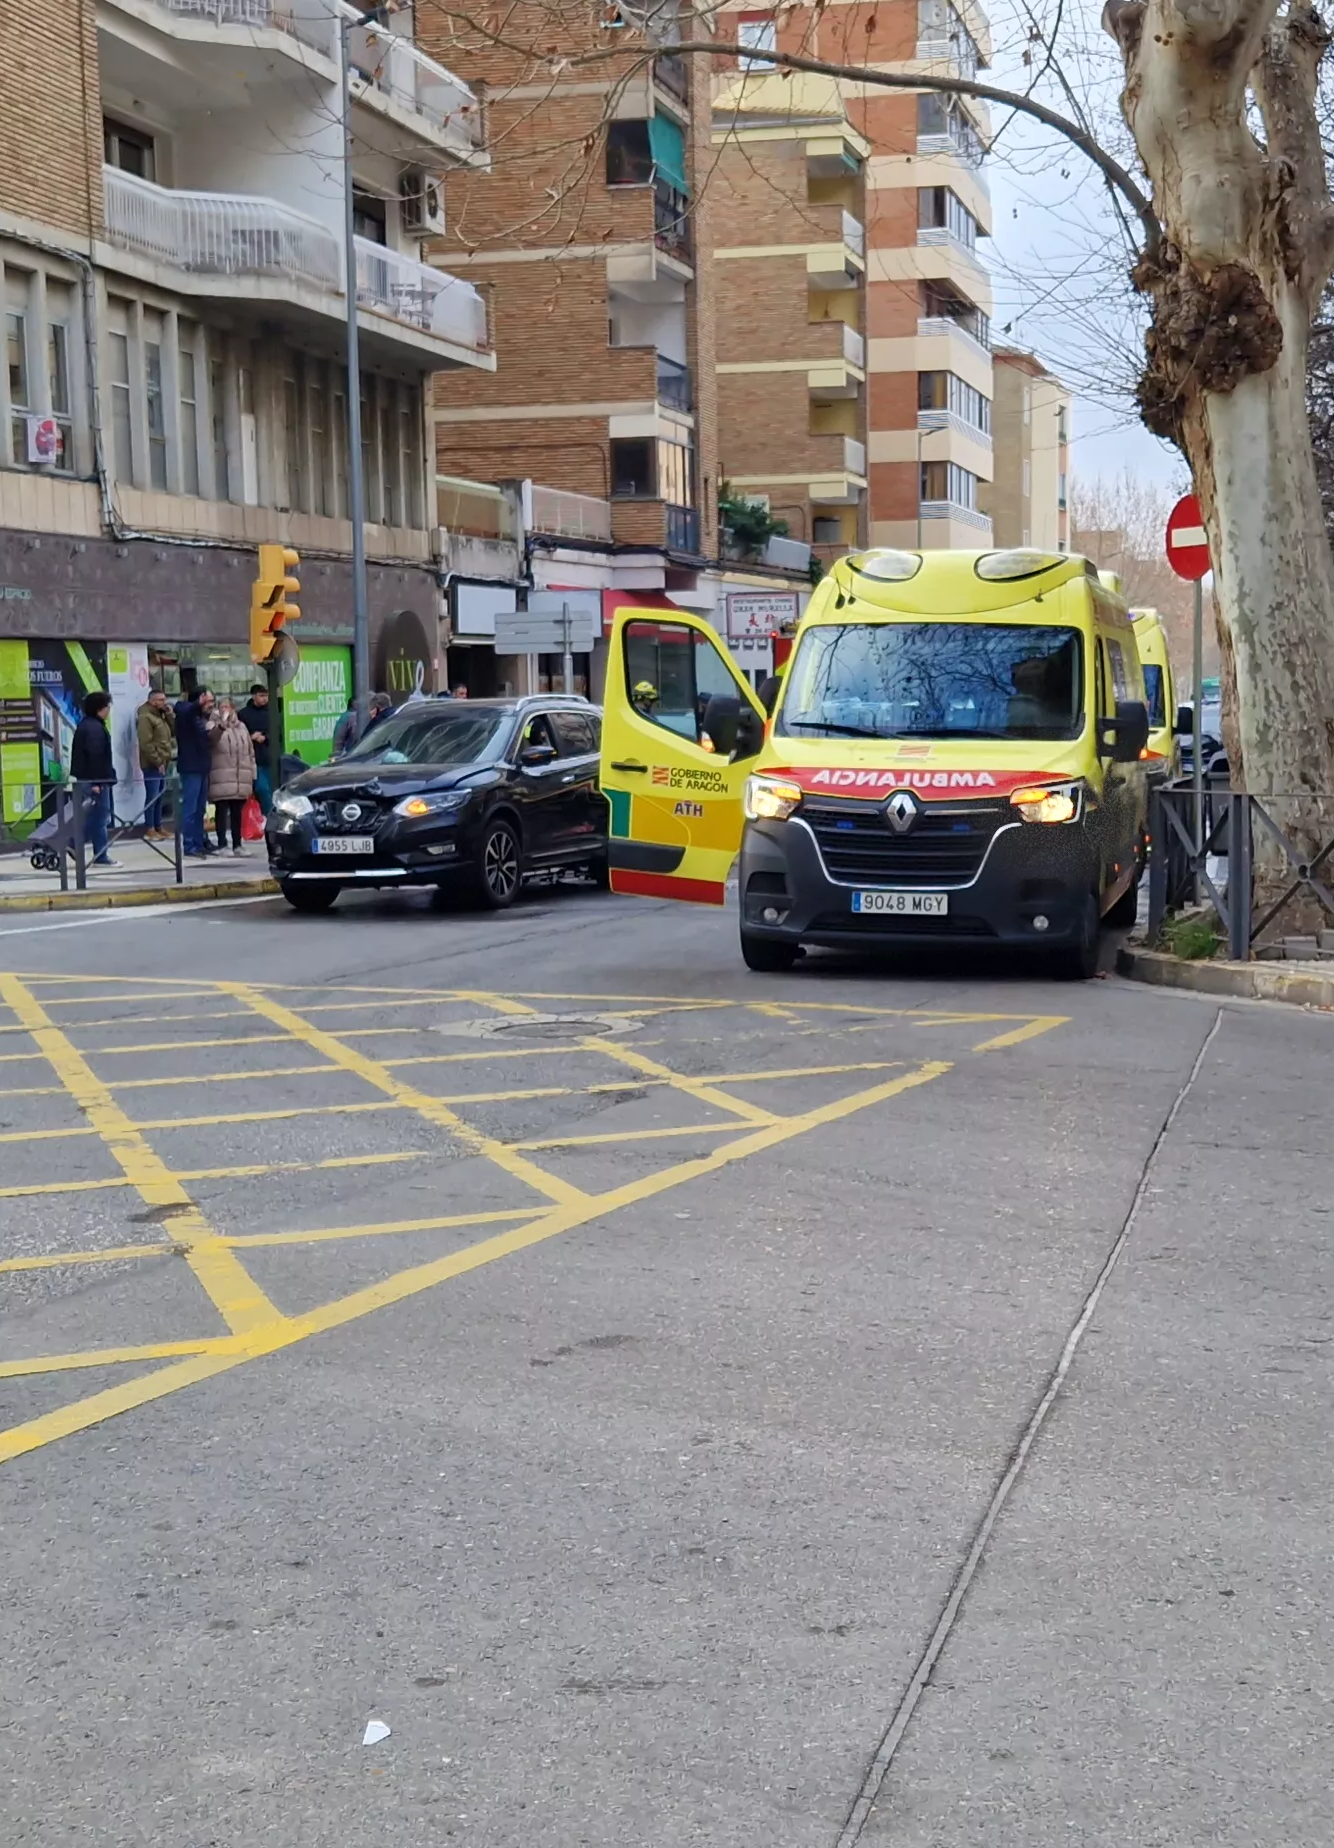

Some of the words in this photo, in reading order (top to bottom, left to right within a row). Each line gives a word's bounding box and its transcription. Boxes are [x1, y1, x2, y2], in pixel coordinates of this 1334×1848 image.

[670, 768, 722, 782] GOBIERNO
[670, 778, 683, 788] DE
[674, 802, 703, 817] ATH
[321, 840, 347, 851] 4955
[352, 840, 371, 851] LJB
[864, 894, 906, 911] 9048
[912, 895, 944, 912] MGY
